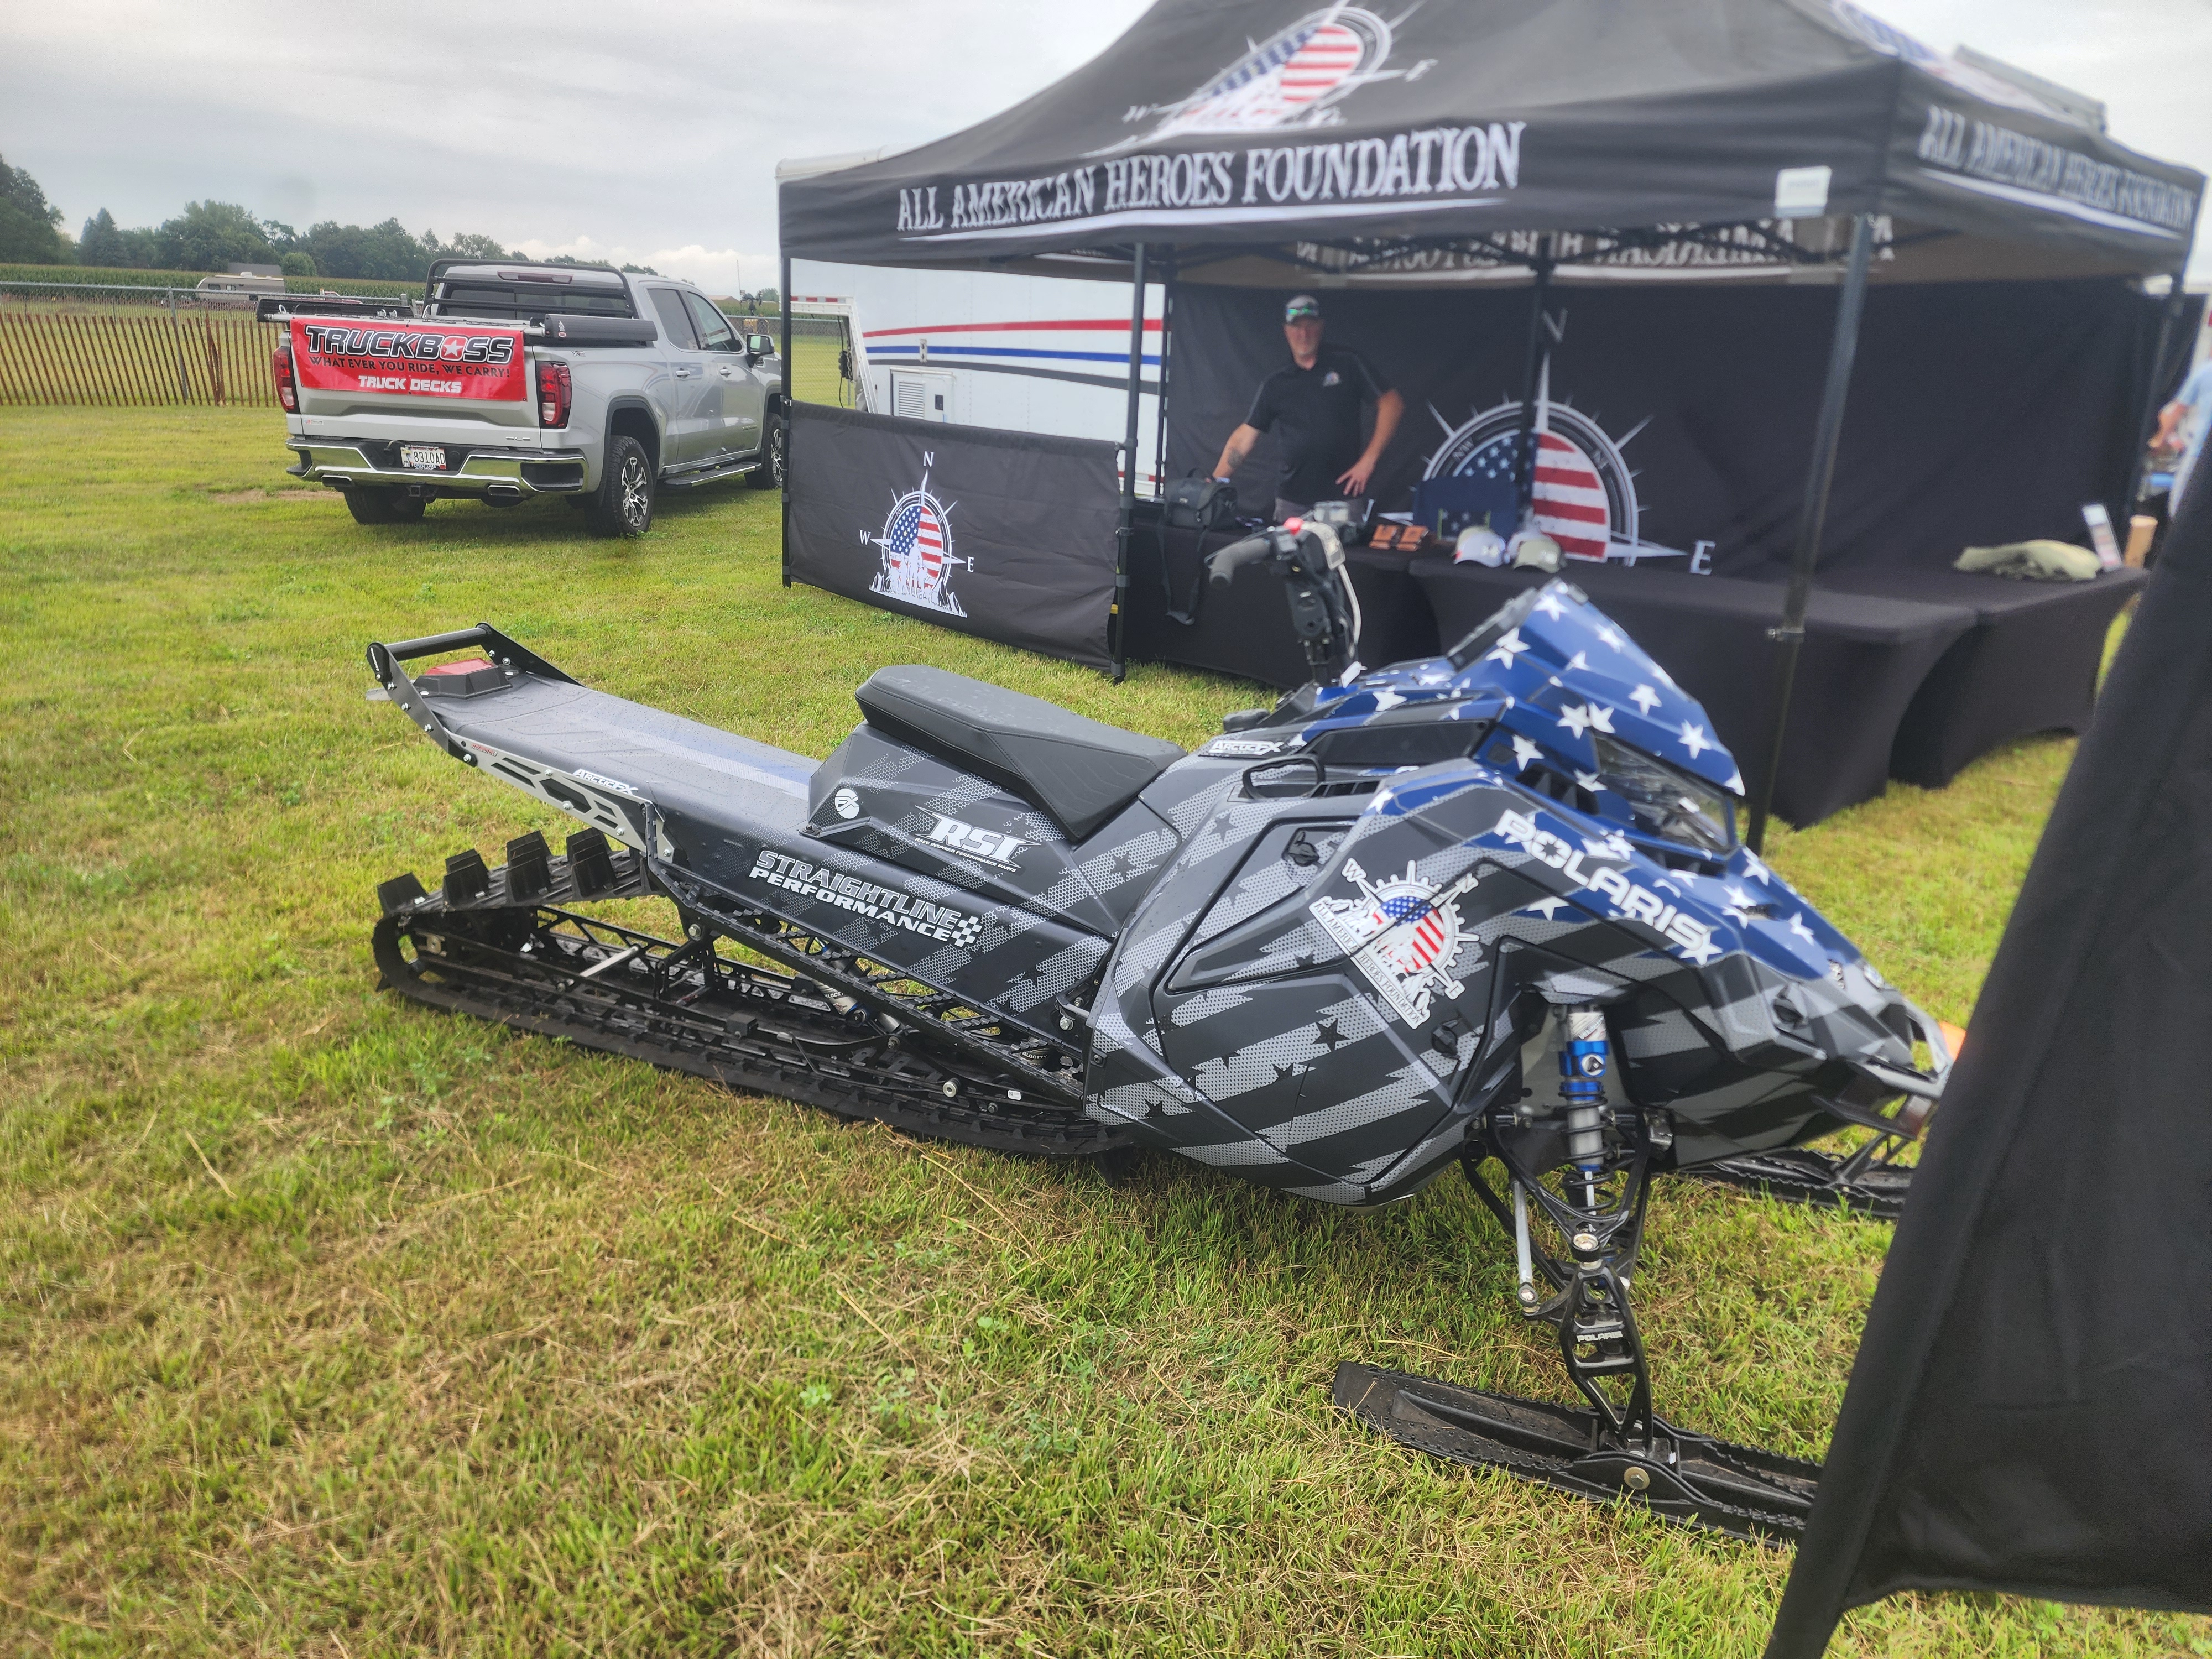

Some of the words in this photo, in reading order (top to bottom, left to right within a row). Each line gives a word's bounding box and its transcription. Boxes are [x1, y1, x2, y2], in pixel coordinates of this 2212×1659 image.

[897, 186, 944, 231] ALL
[950, 165, 1095, 228] AMERICAN
[1104, 150, 1237, 210] HEROES
[1241, 121, 1527, 204] FOUNDATION
[305, 324, 515, 365] TRUCKBOSS
[309, 357, 345, 367] WHAT
[348, 359, 376, 370] EVER
[378, 361, 404, 371] YOU
[408, 362, 439, 375] RIDE,
[442, 364, 462, 375] WE
[465, 366, 510, 378] CARRY!
[358, 375, 406, 390] TRUCK
[410, 379, 462, 394] DECKS
[413, 451, 445, 465] 8310AD
[923, 451, 935, 467] N
[859, 529, 872, 545] W
[967, 556, 975, 573] E
[1689, 540, 1716, 575] E
[915, 837, 930, 846] RACE
[930, 842, 956, 853] INSPIRED
[955, 851, 998, 867] PERFORMANCE
[997, 864, 1017, 873] PARTS
[924, 811, 1029, 864] RSI
[756, 850, 962, 930] STRAIGHTLINE
[1494, 808, 1710, 952] POLARIS
[749, 866, 952, 942] PERFORMANCE
[1313, 903, 1328, 919] ALL
[1326, 918, 1359, 953] AMERICA
[1383, 980, 1422, 1023] FOUNDATION
[1577, 1331, 1623, 1342] POLARIS
